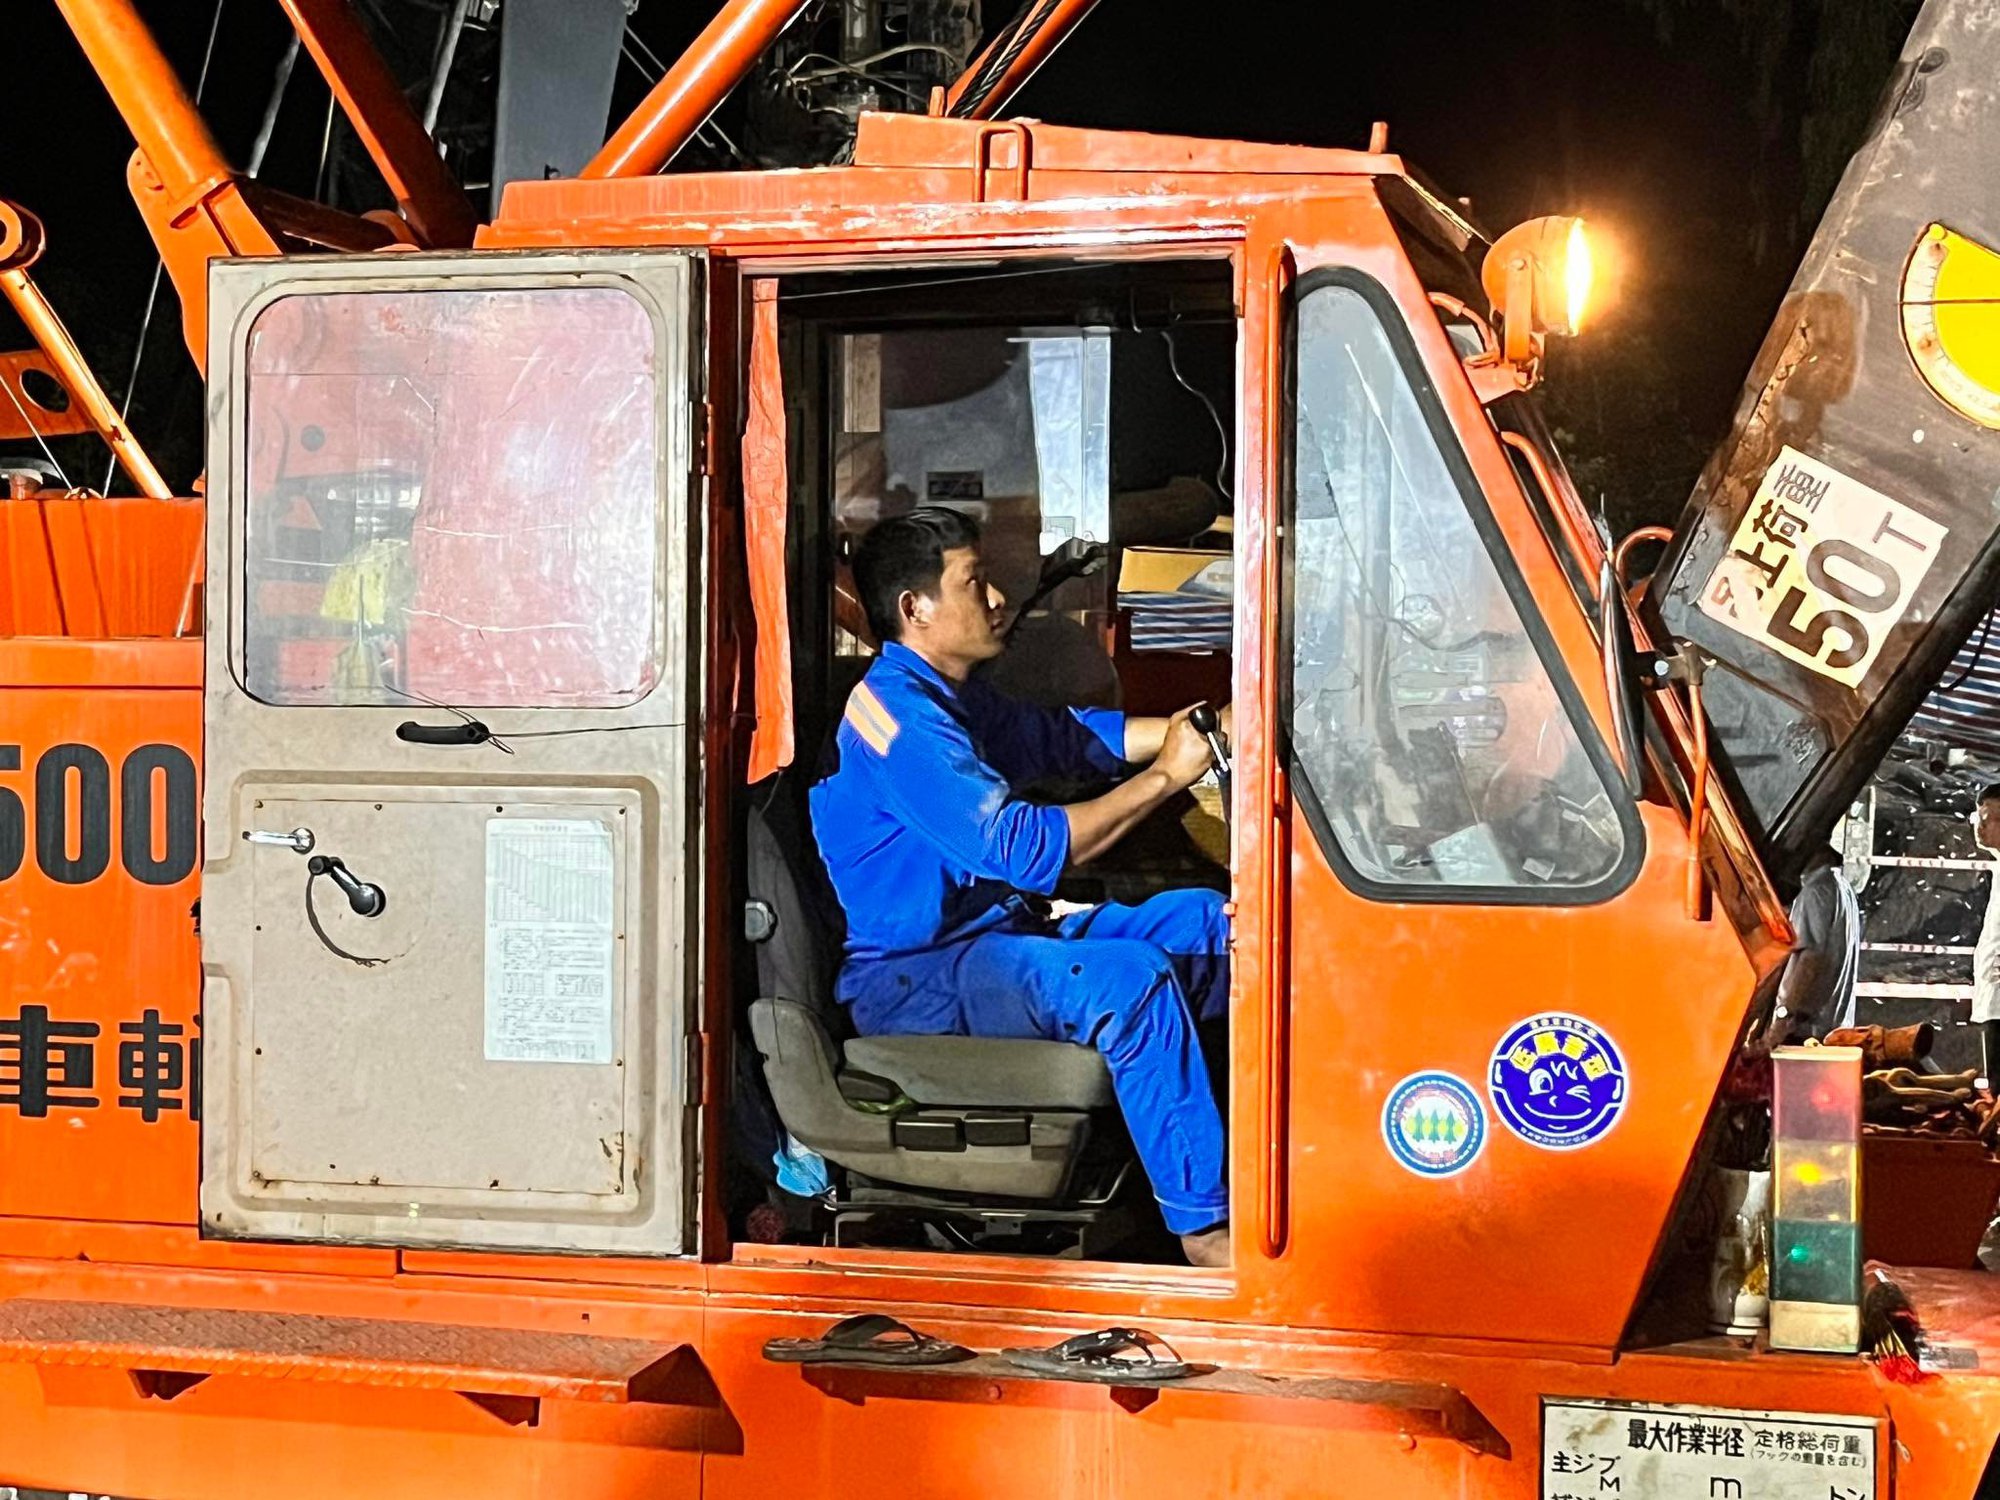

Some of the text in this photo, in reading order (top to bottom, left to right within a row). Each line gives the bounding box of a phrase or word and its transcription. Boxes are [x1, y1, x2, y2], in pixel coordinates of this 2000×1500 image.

[1627, 1418, 1861, 1457] 最大作業半径 定格総荷重
[1551, 1450, 1622, 1475] 主ジブ
[1600, 1475, 1743, 1499] M m
